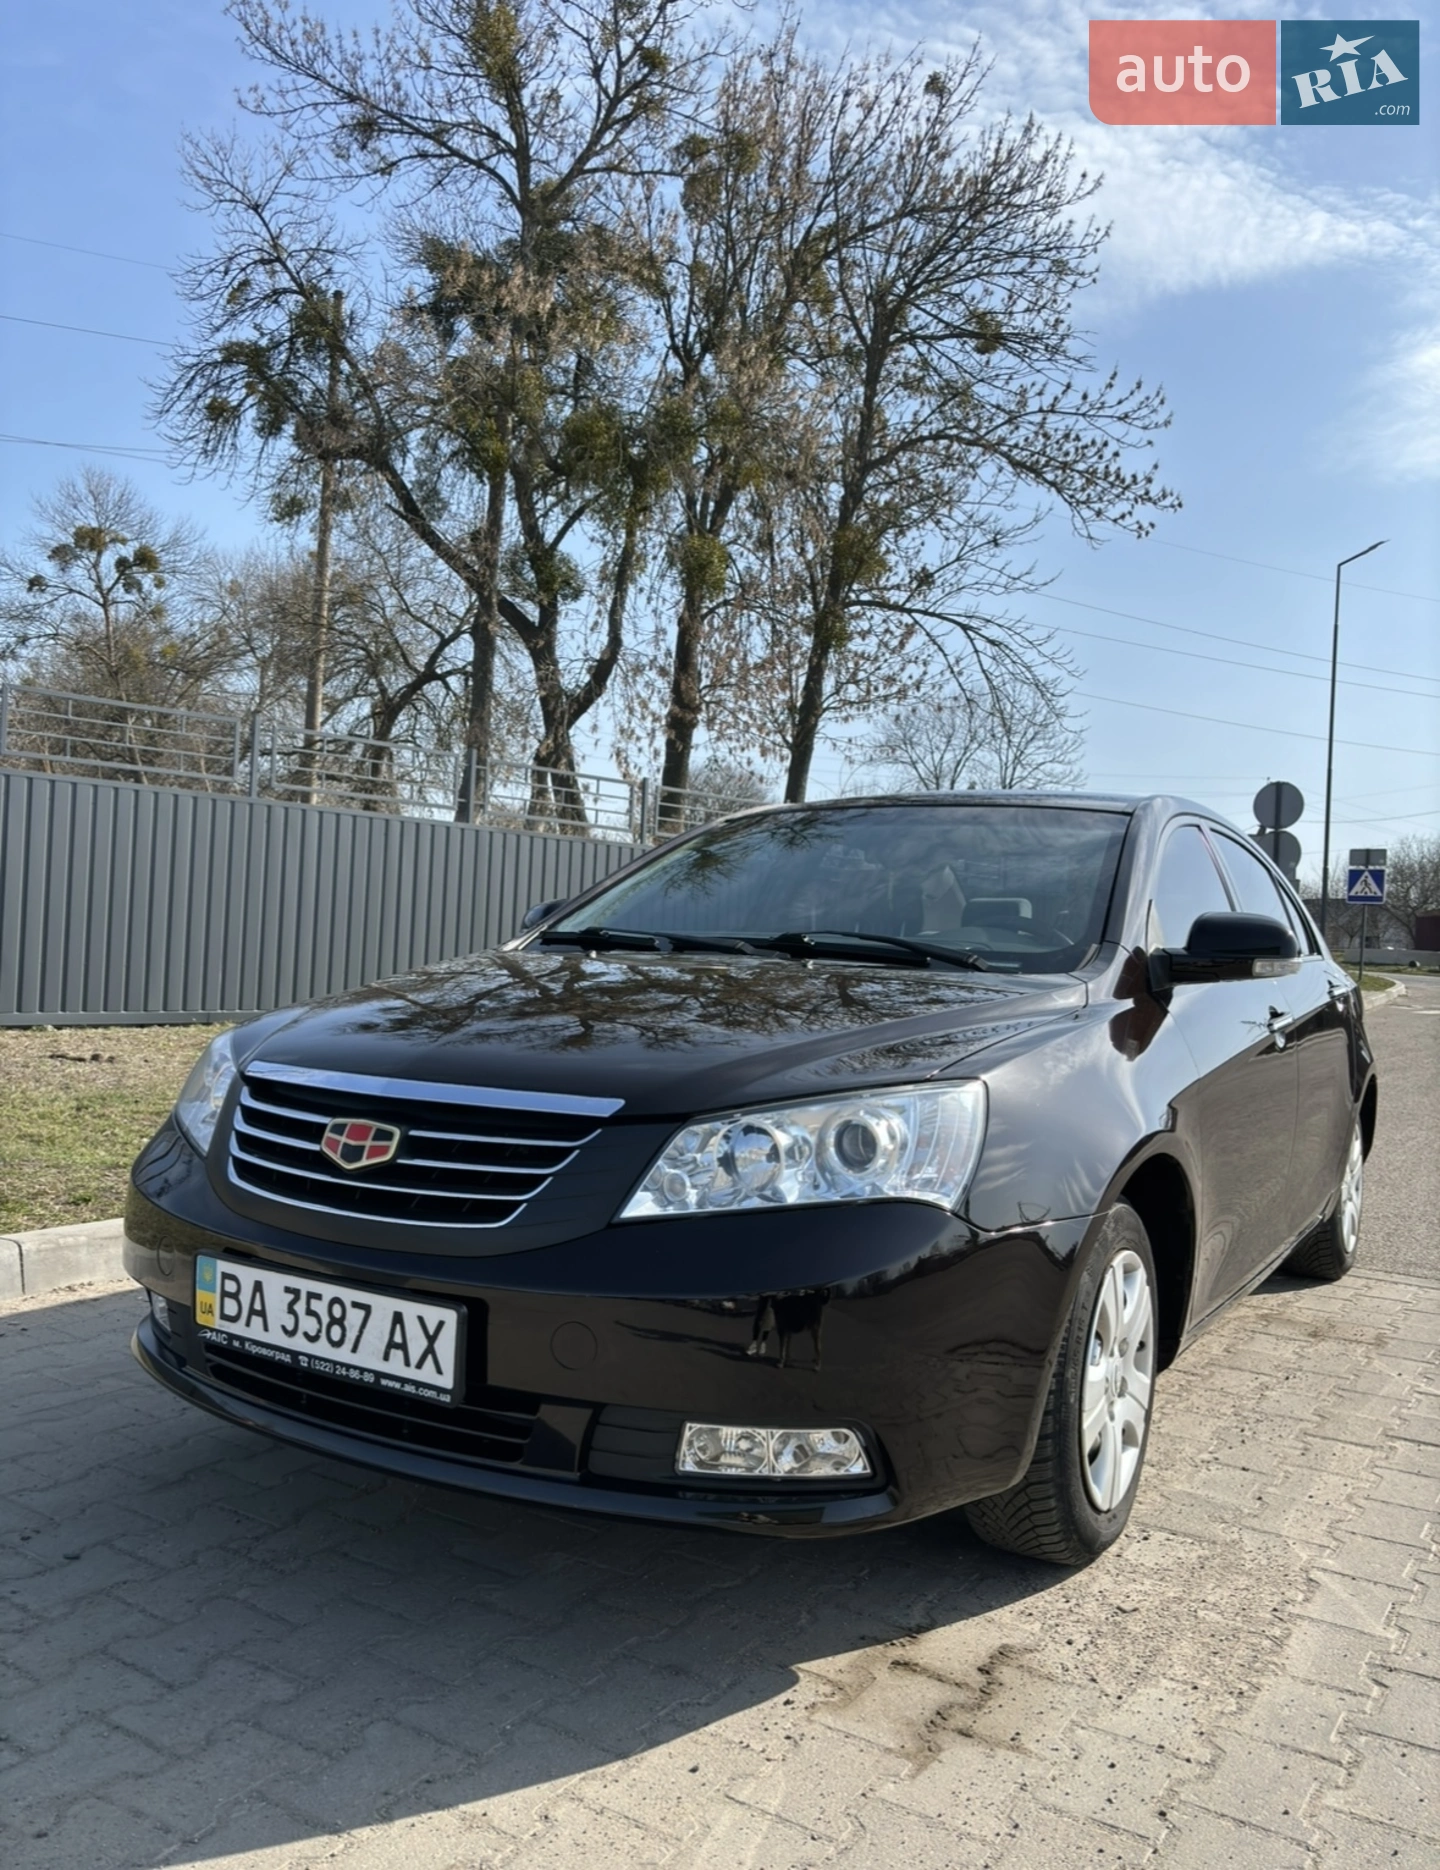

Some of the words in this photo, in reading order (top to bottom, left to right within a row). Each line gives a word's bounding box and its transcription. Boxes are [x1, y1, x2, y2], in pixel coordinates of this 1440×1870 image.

[200, 1300, 214, 1317] UA
[220, 1271, 269, 1333] BA
[281, 1285, 372, 1355] 3587
[382, 1310, 446, 1376] AX
[244, 1341, 292, 1363] Кіровоград
[310, 1358, 334, 1374] (522)
[335, 1364, 375, 1383] 24-86-89
[380, 1377, 451, 1402] www.ais.com.ua
